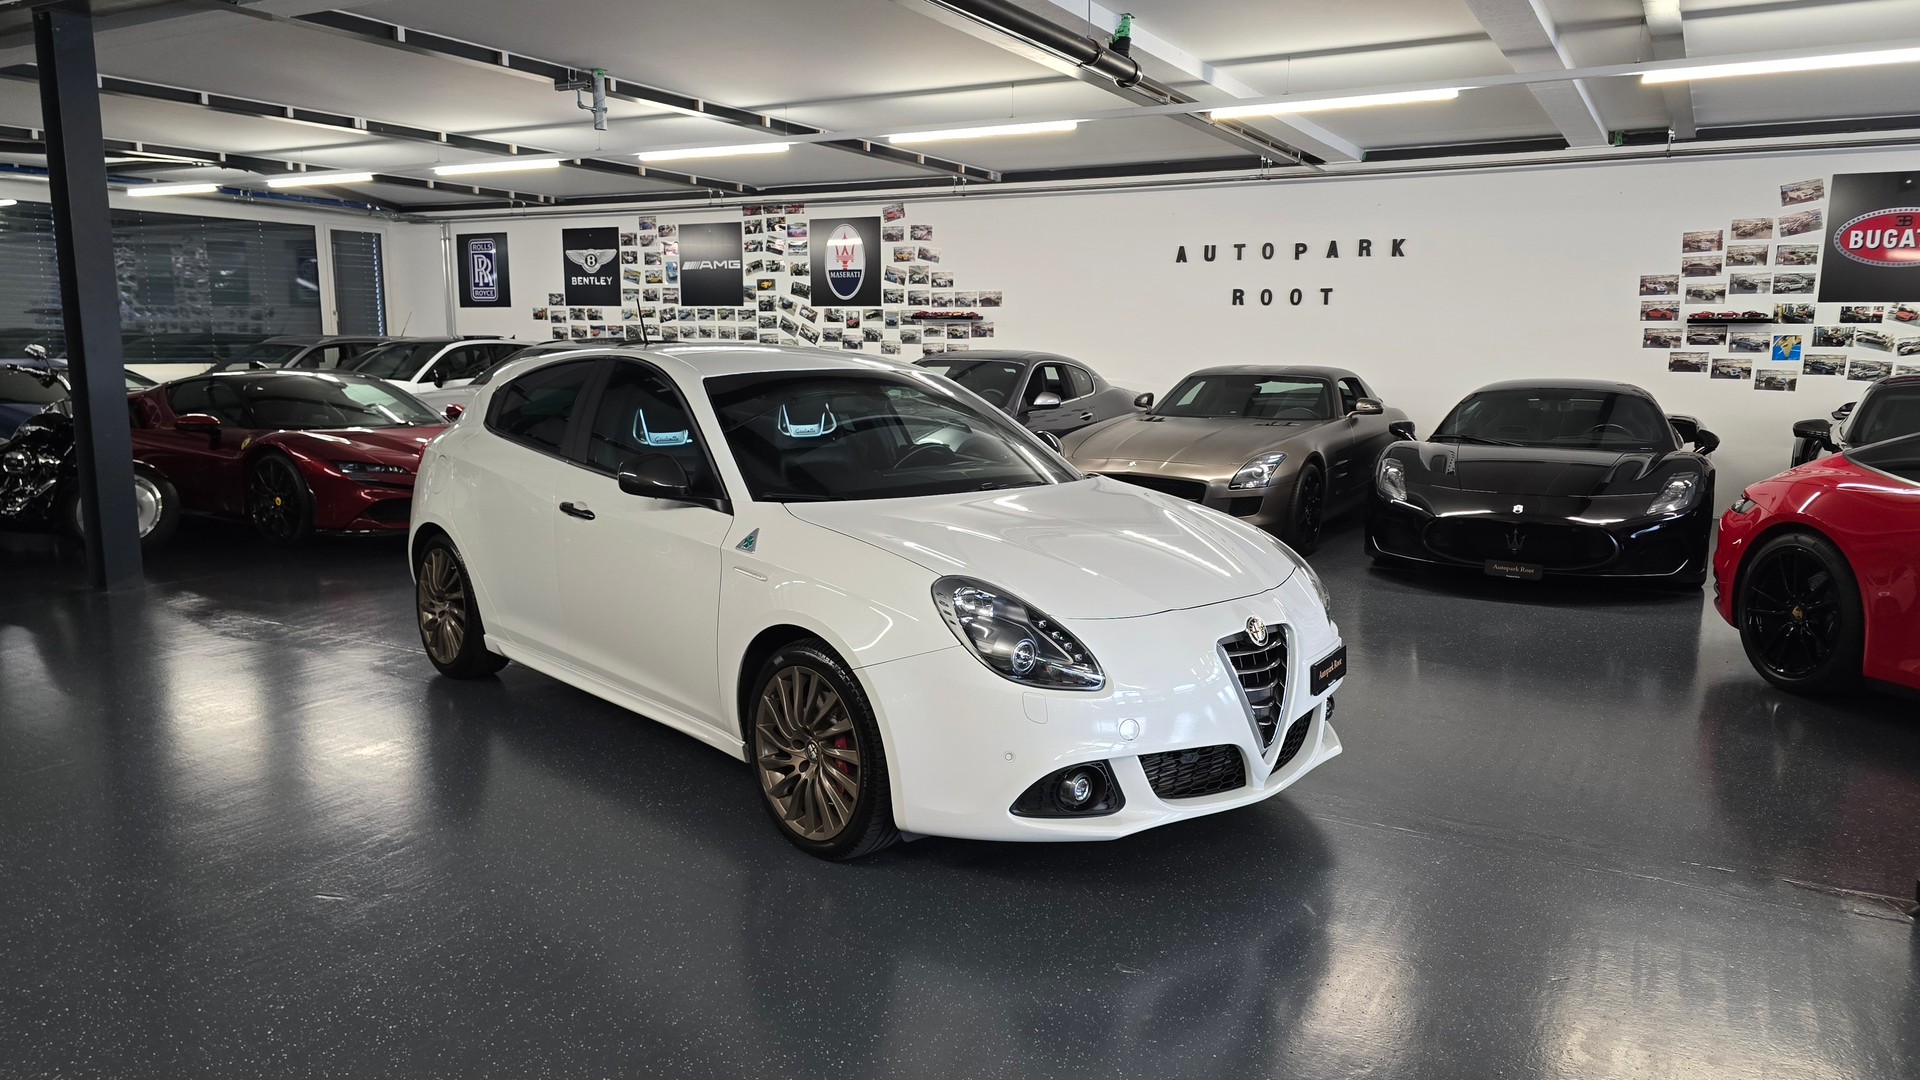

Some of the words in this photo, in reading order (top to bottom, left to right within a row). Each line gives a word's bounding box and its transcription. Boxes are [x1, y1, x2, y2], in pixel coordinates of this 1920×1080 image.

[1848, 228, 1920, 249] BUGA
[472, 243, 492, 251] ROLLS
[1175, 238, 1407, 263] AUTOPARK
[699, 259, 741, 270] AMG
[830, 271, 861, 279] MASERATI
[571, 276, 613, 286] BENTLEY
[474, 289, 494, 297] ROYCE
[1231, 287, 1334, 306] ROOT
[1492, 563, 1520, 573] Autopark
